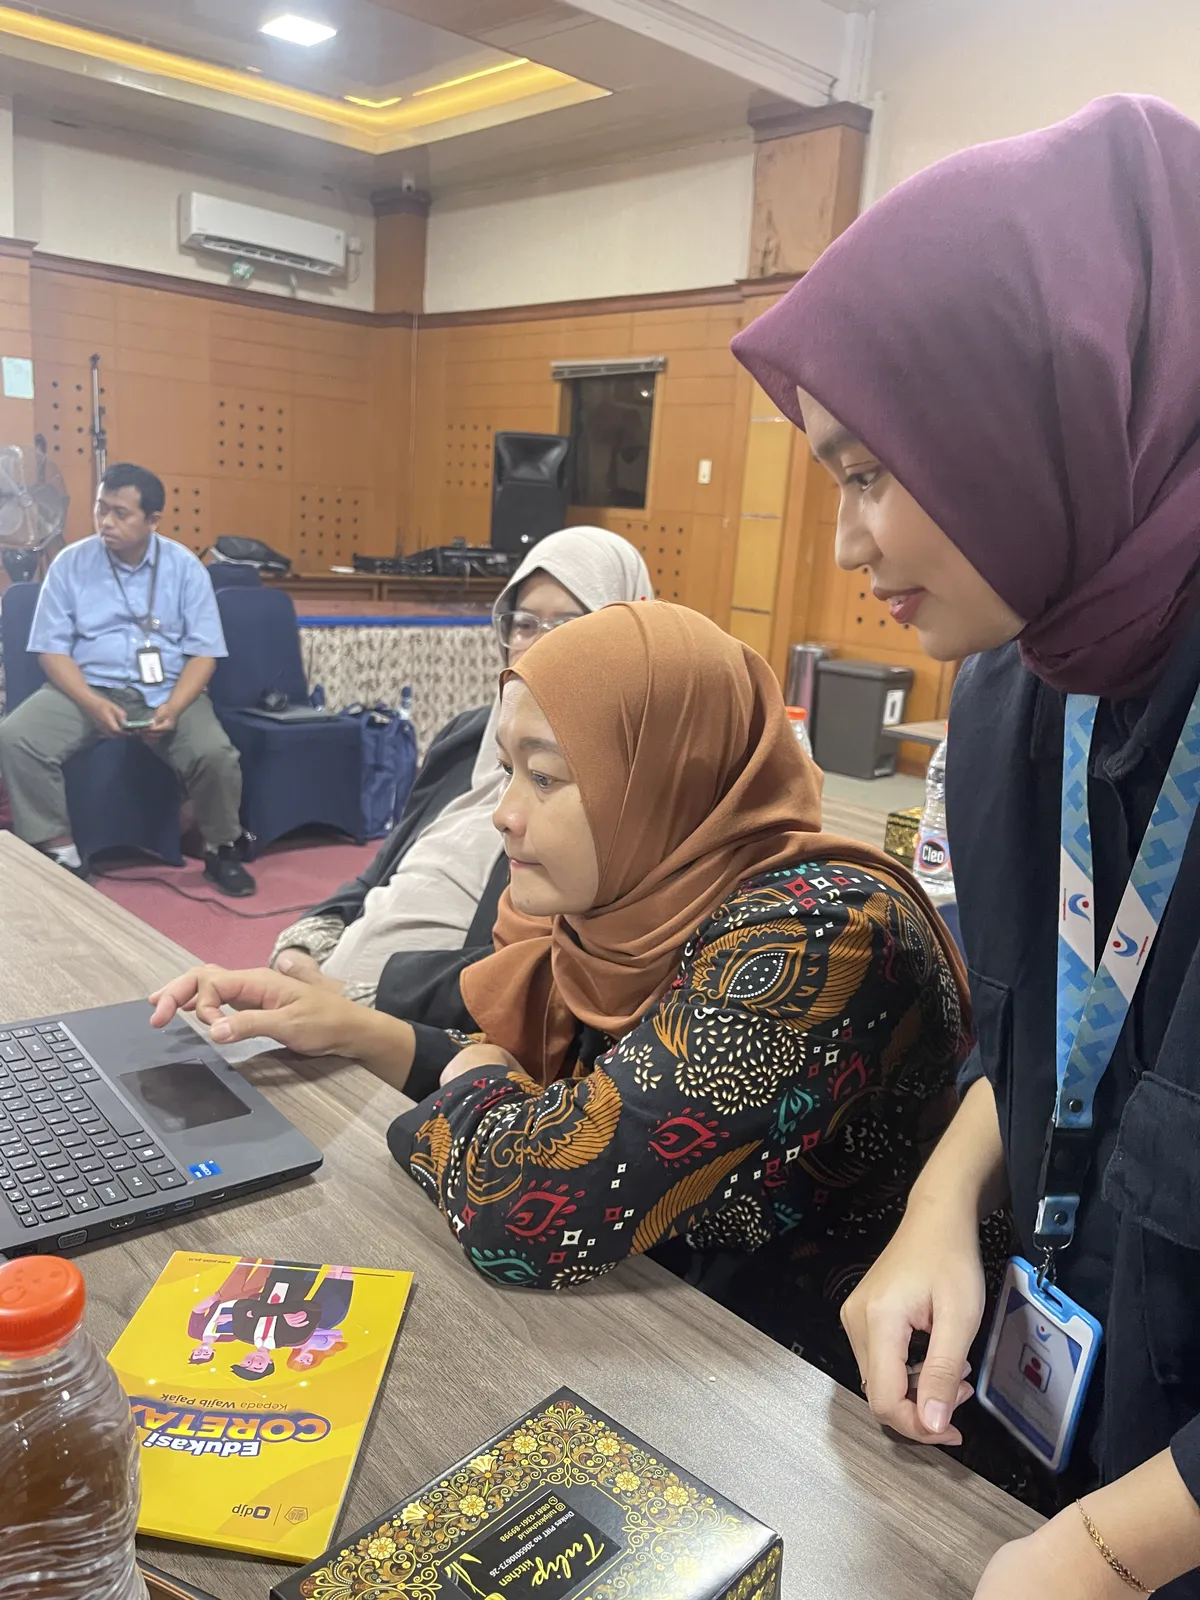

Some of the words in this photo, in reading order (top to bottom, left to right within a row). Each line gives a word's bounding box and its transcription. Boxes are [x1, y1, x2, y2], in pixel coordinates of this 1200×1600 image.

[922, 844, 944, 863] Cleo
[161, 1393, 197, 1406] Pajak
[199, 1398, 236, 1409] Wajib
[239, 1402, 288, 1411] Kepada
[142, 1432, 261, 1457] Edukasi
[499, 1503, 550, 1543] 0881-0361-89998
[517, 1509, 558, 1541] tulipkitchen.id
[555, 1510, 575, 1528] Dinkes
[533, 1535, 543, 1544] no
[541, 1525, 557, 1539] PIRT
[531, 1533, 605, 1587] Tulip
[498, 1559, 535, 1587] kitchen
